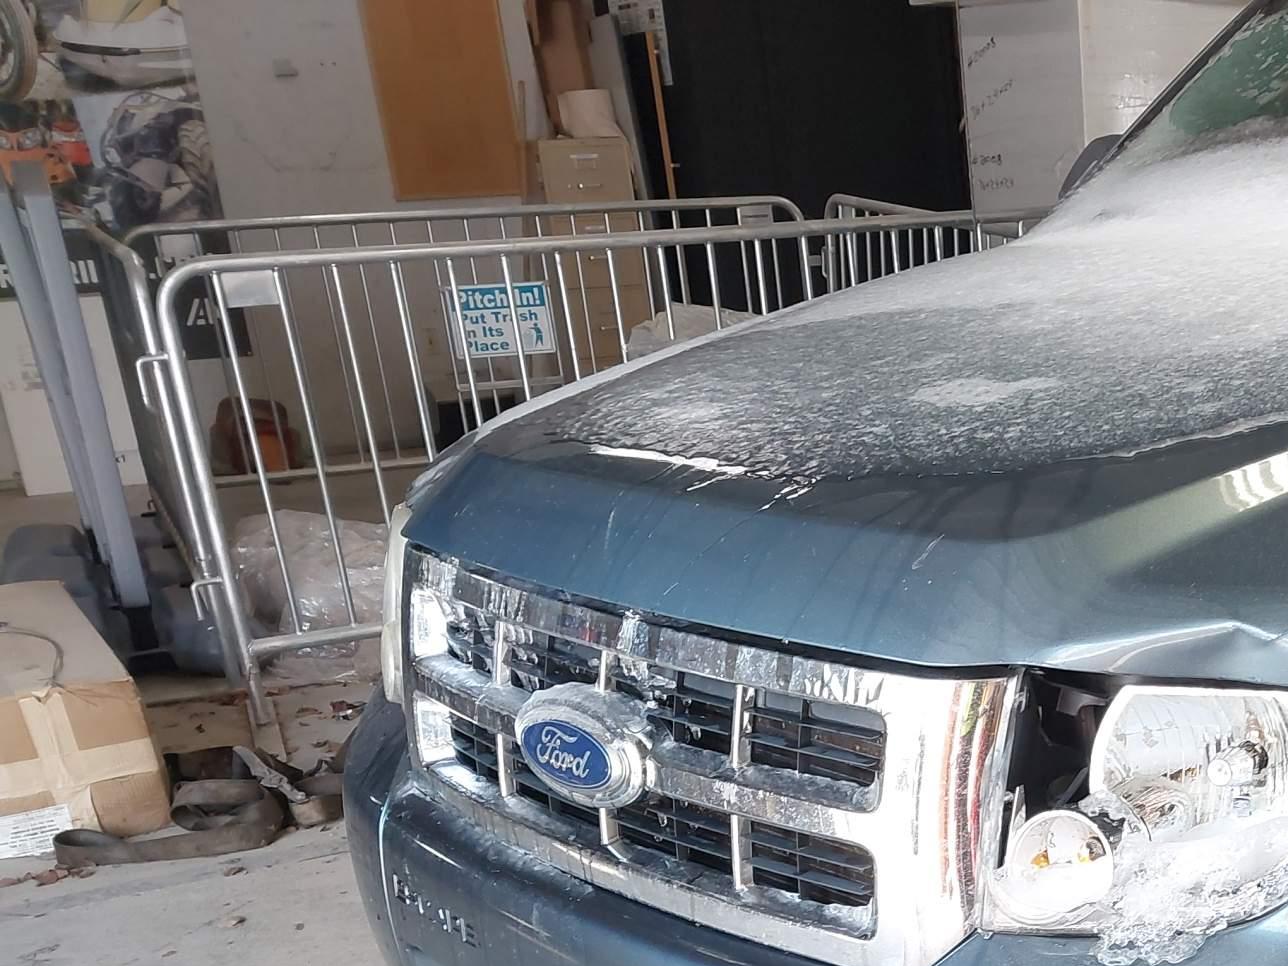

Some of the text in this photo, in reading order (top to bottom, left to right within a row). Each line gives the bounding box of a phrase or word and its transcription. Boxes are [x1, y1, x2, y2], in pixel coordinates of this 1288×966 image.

[457, 288, 541, 309] Pitch In!
[491, 310, 539, 323] Trsh
[482, 325, 505, 338] Its
[536, 726, 591, 779] Ford
